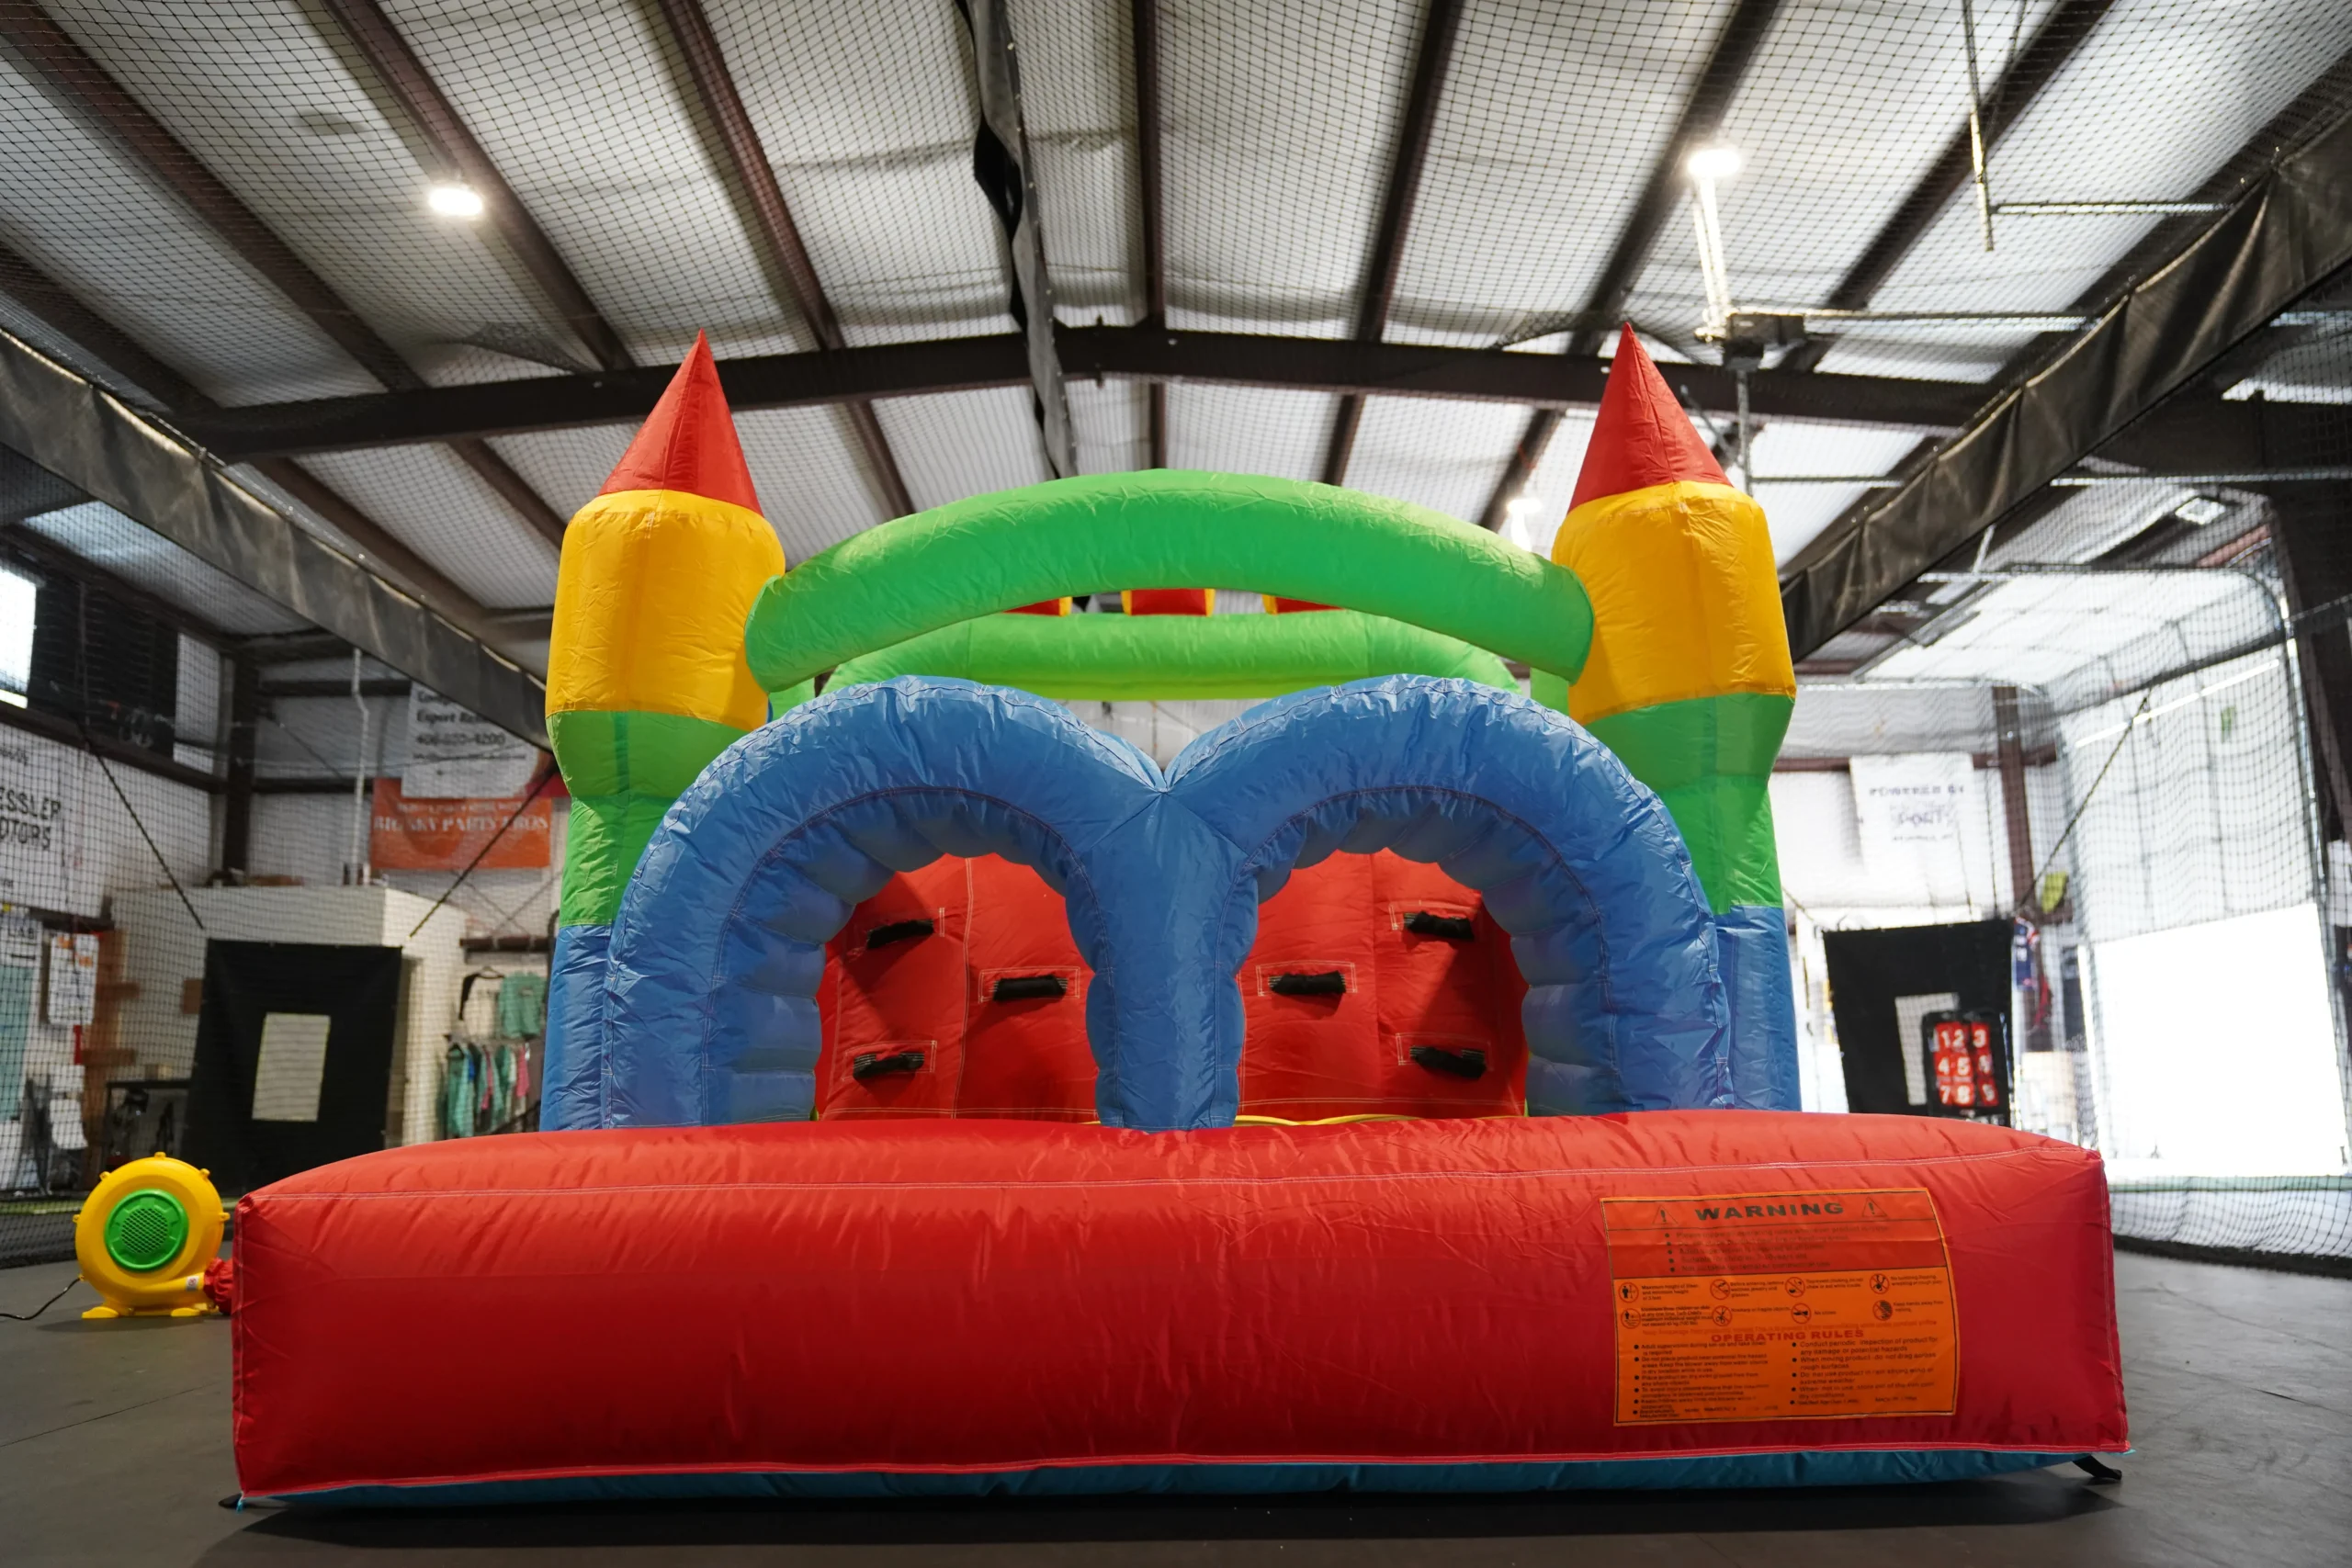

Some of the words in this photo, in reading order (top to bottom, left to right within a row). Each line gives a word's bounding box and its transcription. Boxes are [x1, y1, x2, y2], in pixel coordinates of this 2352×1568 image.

[1941, 1030, 1951, 1048] 1
[1952, 1028, 1965, 1048] 2
[1973, 1028, 1986, 1048] 3
[1938, 1056, 1951, 1076] 4
[1957, 1055, 1971, 1076] 5
[1939, 1085, 1951, 1104] 7
[1957, 1085, 1971, 1104] 8
[1695, 1202, 1844, 1221] WARNING
[1711, 1331, 1807, 1343] OPERATING
[1811, 1328, 1864, 1341] RULES
